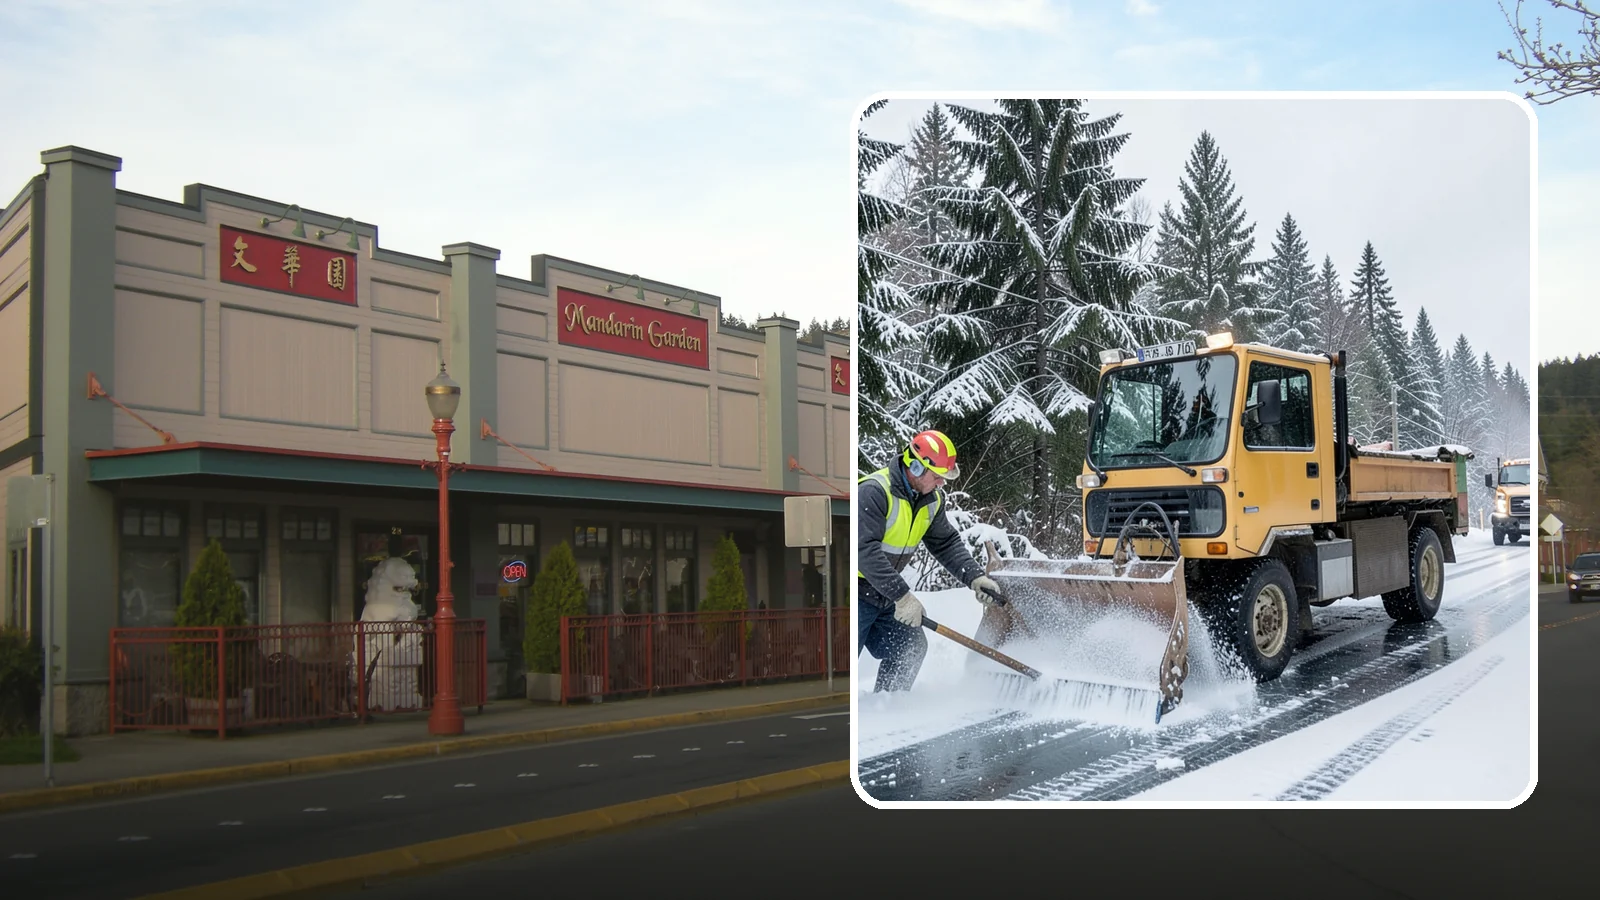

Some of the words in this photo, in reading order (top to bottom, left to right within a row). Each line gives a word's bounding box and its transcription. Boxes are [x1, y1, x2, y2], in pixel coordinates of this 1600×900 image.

[230, 235, 346, 291] 文華園
[564, 302, 644, 341] Mandarin
[648, 320, 701, 352] Garden
[503, 565, 527, 578] OPEN
